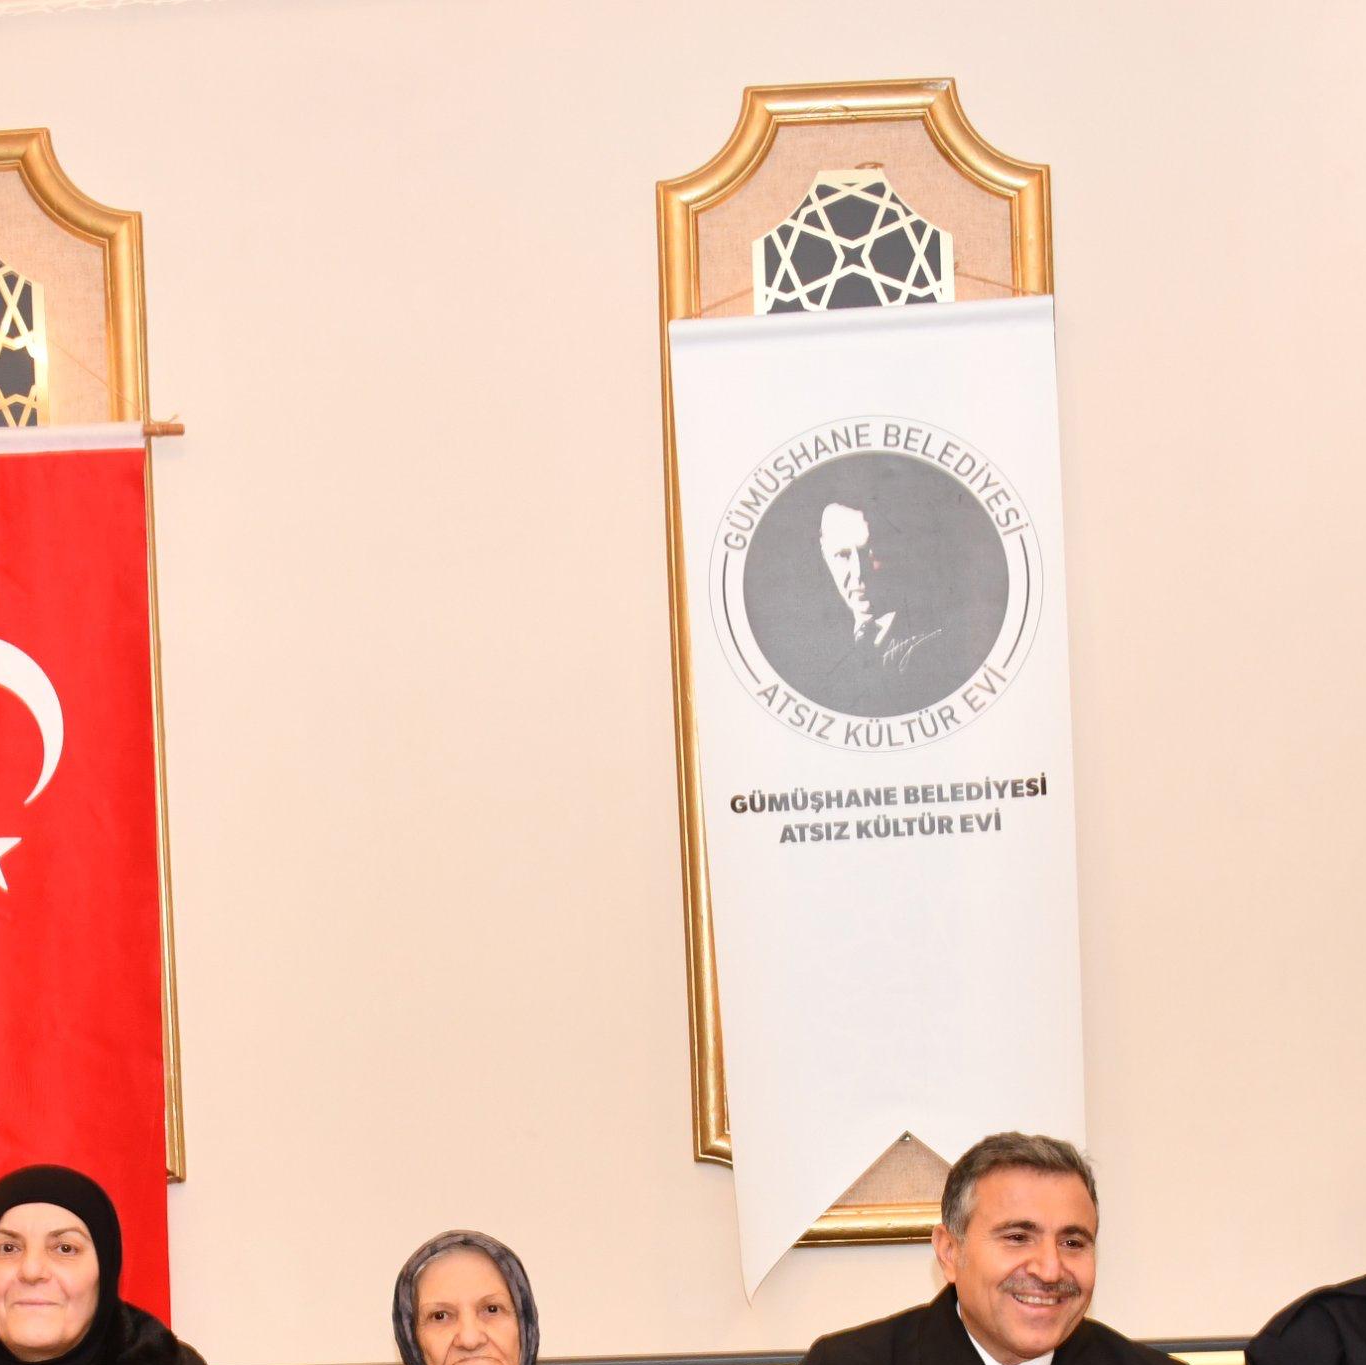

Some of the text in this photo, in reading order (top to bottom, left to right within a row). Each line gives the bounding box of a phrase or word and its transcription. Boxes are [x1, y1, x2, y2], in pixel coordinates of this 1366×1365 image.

[724, 423, 1029, 551] GÜMÜŞHANE BELEDİYESİ
[756, 664, 1007, 748] ATSIZ KÜLTÜR EVİ
[730, 772, 1047, 814] GÜMÜŞHANE BELEDİYESİ
[779, 807, 1002, 843] ATSIZ KÜLTÜR EVİ
